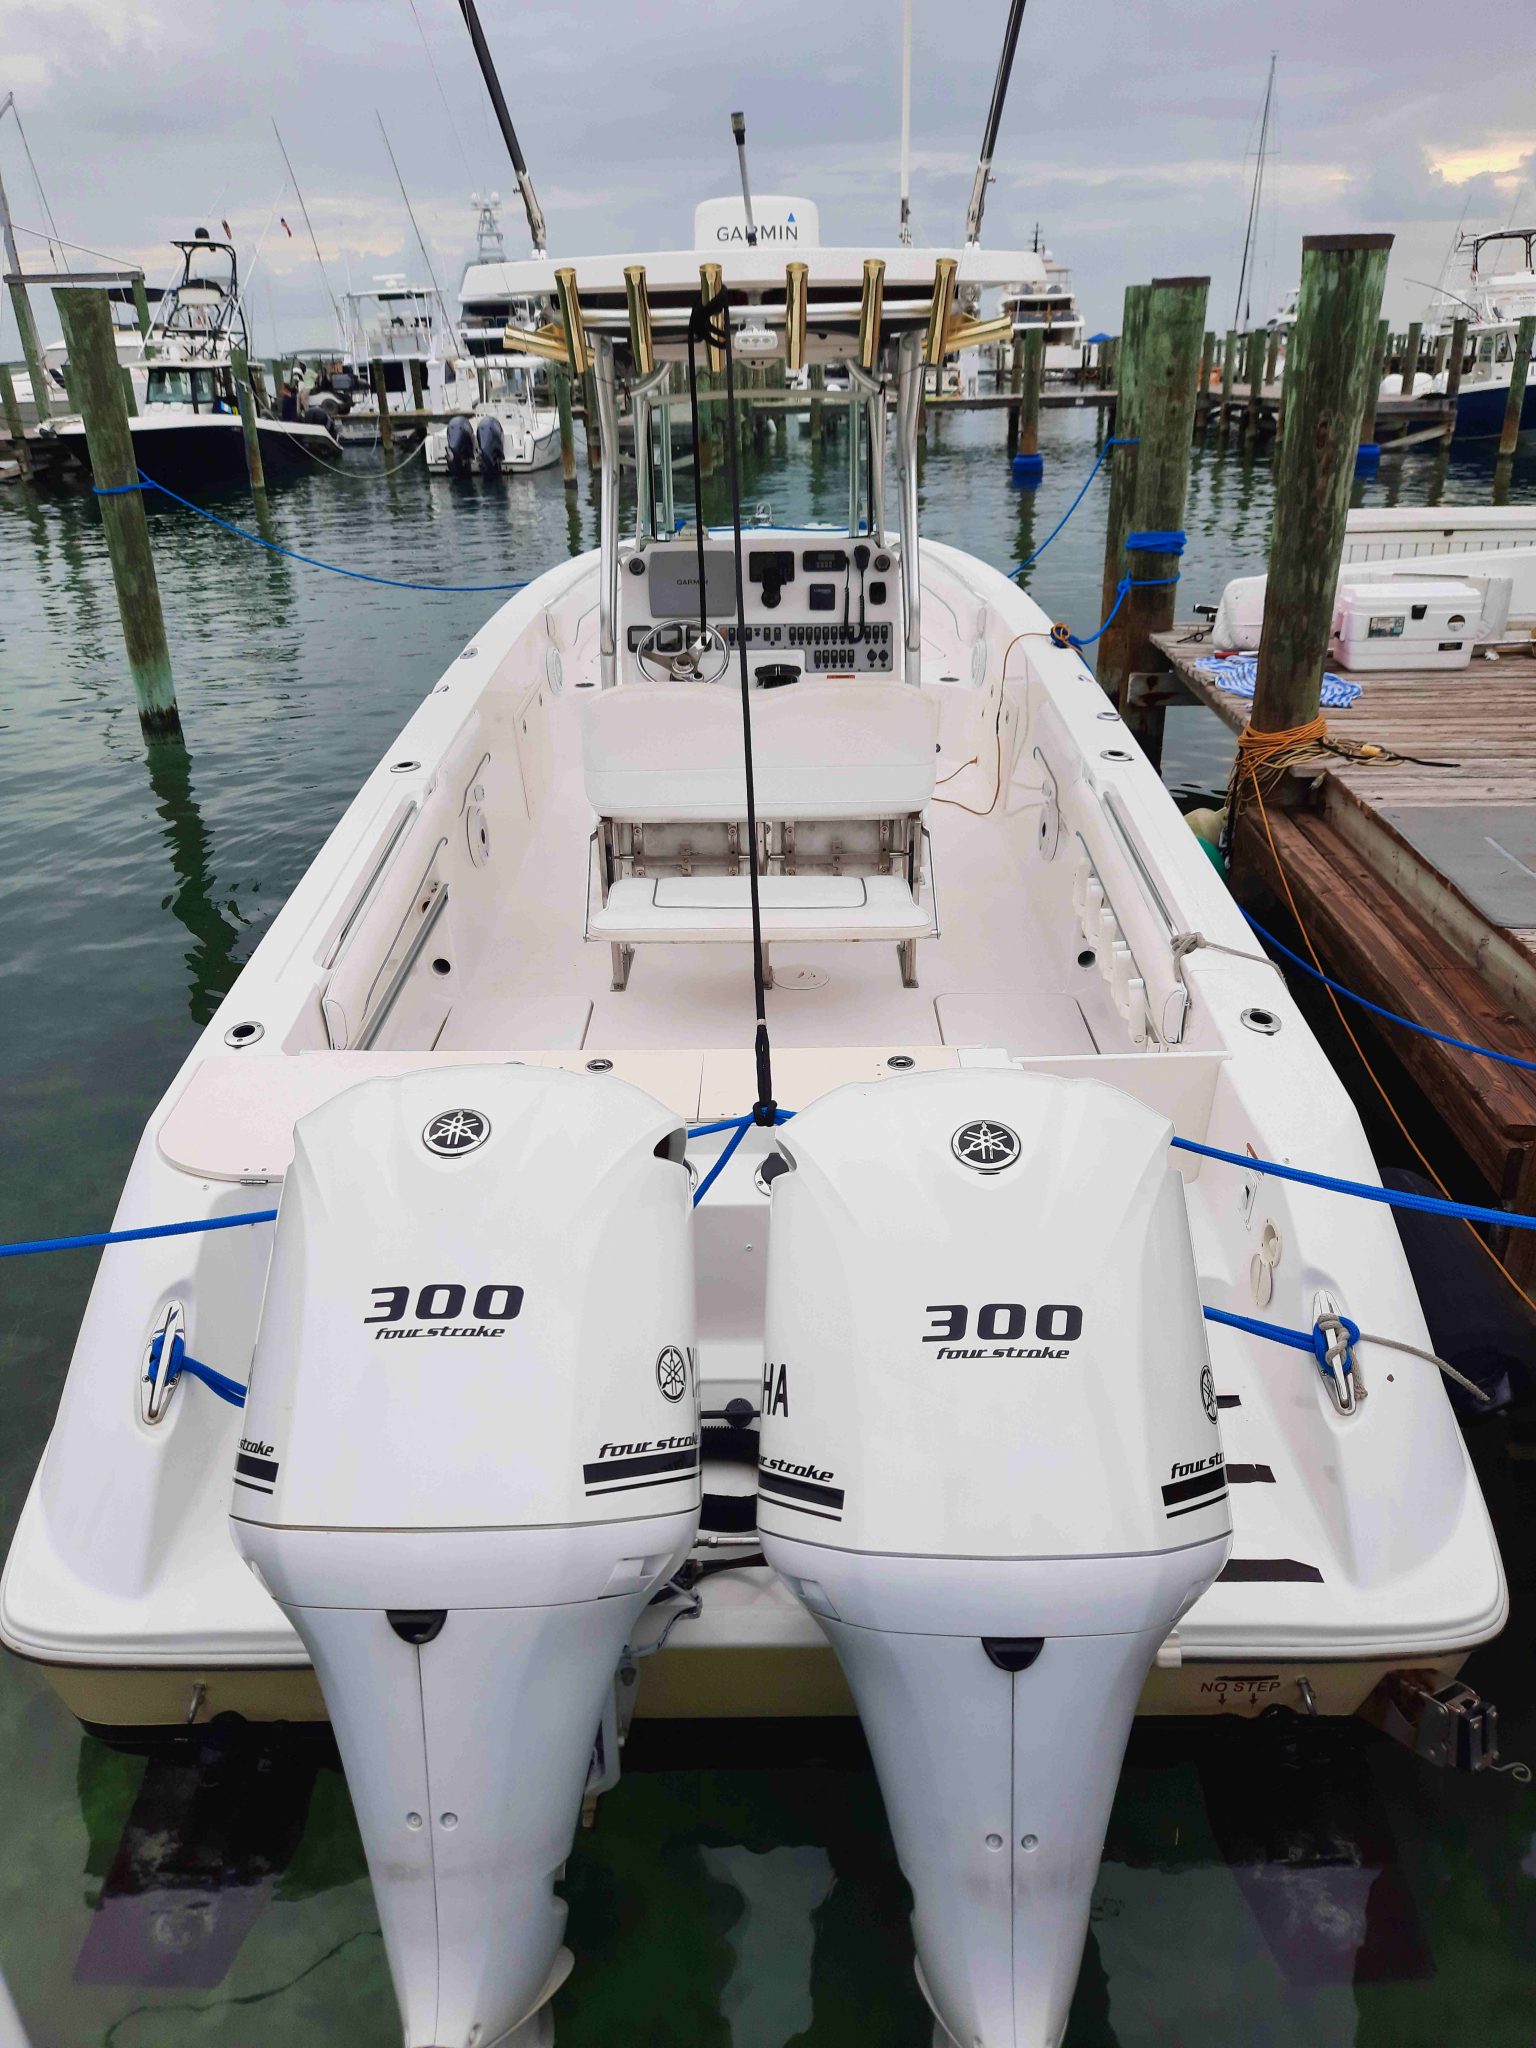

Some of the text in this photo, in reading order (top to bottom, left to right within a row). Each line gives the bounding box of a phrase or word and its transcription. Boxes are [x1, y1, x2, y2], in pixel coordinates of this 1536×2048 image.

[363, 1284, 525, 1324] 300
[922, 1303, 1084, 1343] 300
[656, 1432, 698, 1450] strok
[1200, 1681, 1281, 1693] NO STEP
